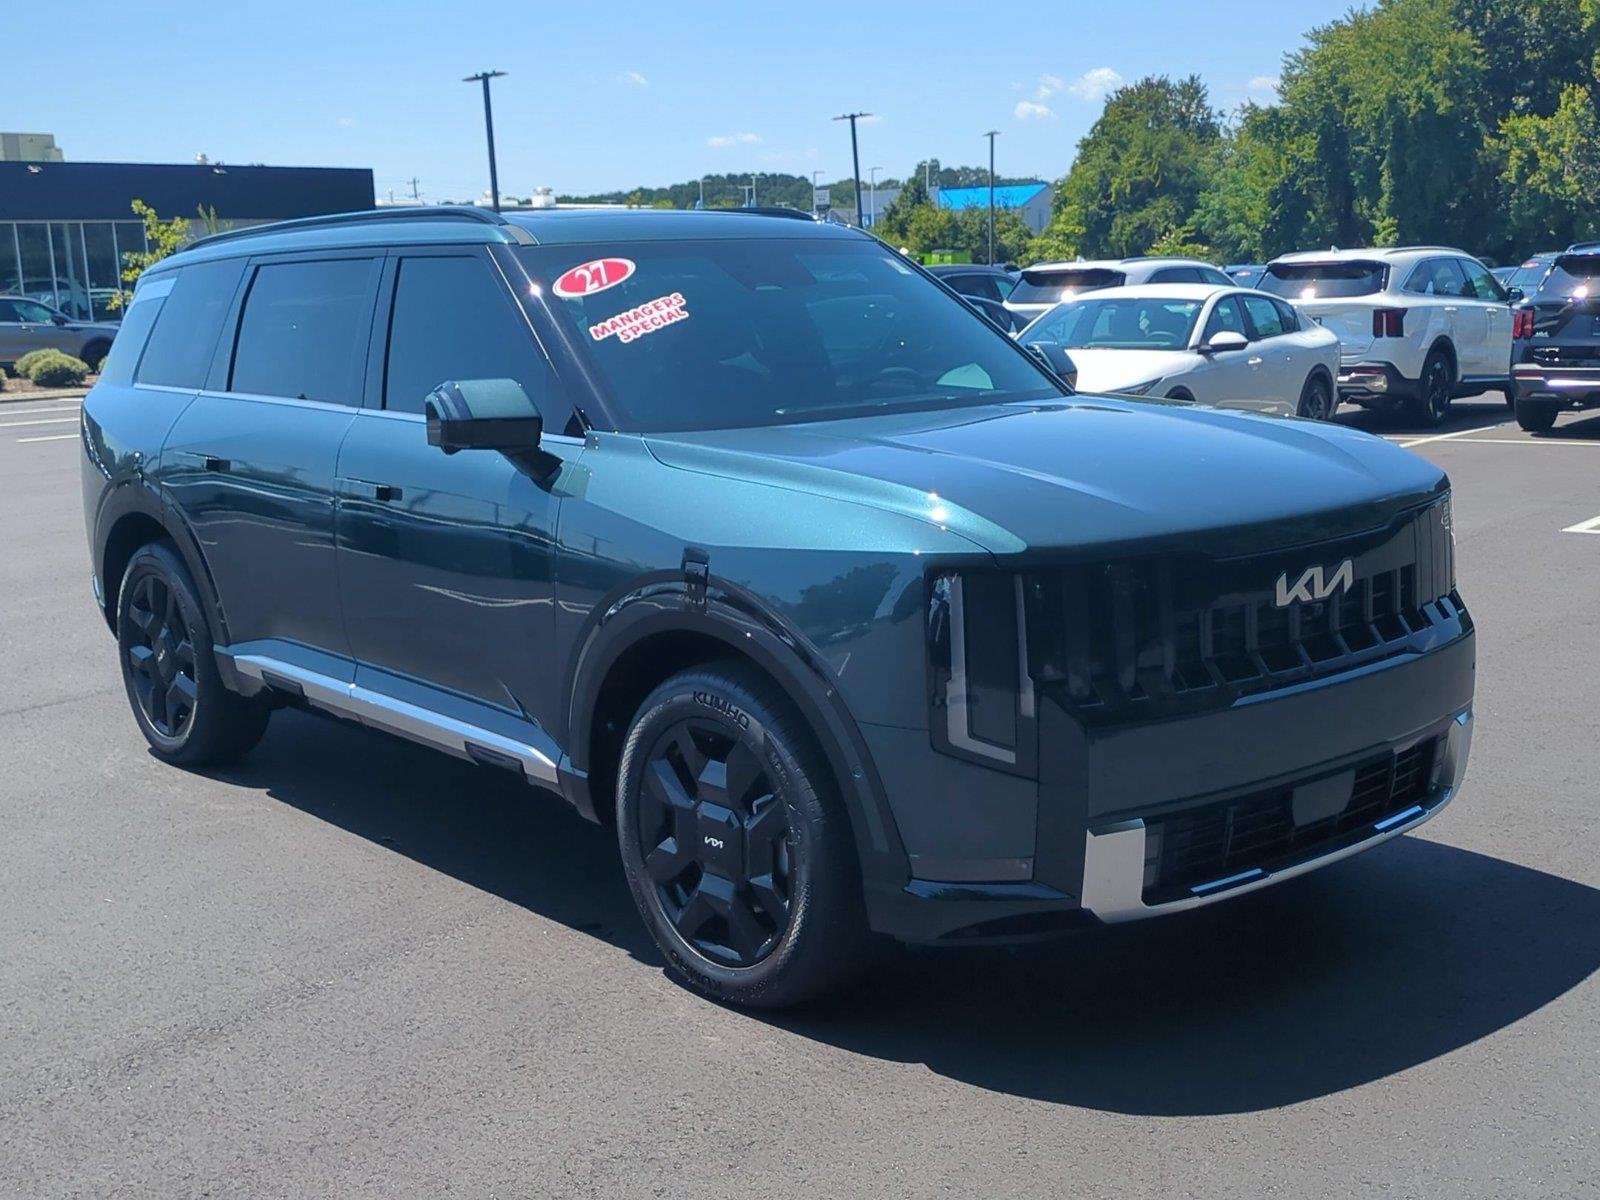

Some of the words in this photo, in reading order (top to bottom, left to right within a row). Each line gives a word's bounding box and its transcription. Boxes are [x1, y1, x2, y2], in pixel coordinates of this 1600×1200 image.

[575, 261, 609, 292] 27
[592, 294, 684, 339] MANAGERS
[620, 308, 687, 341] SPECIAL
[693, 691, 750, 730] KUMHO
